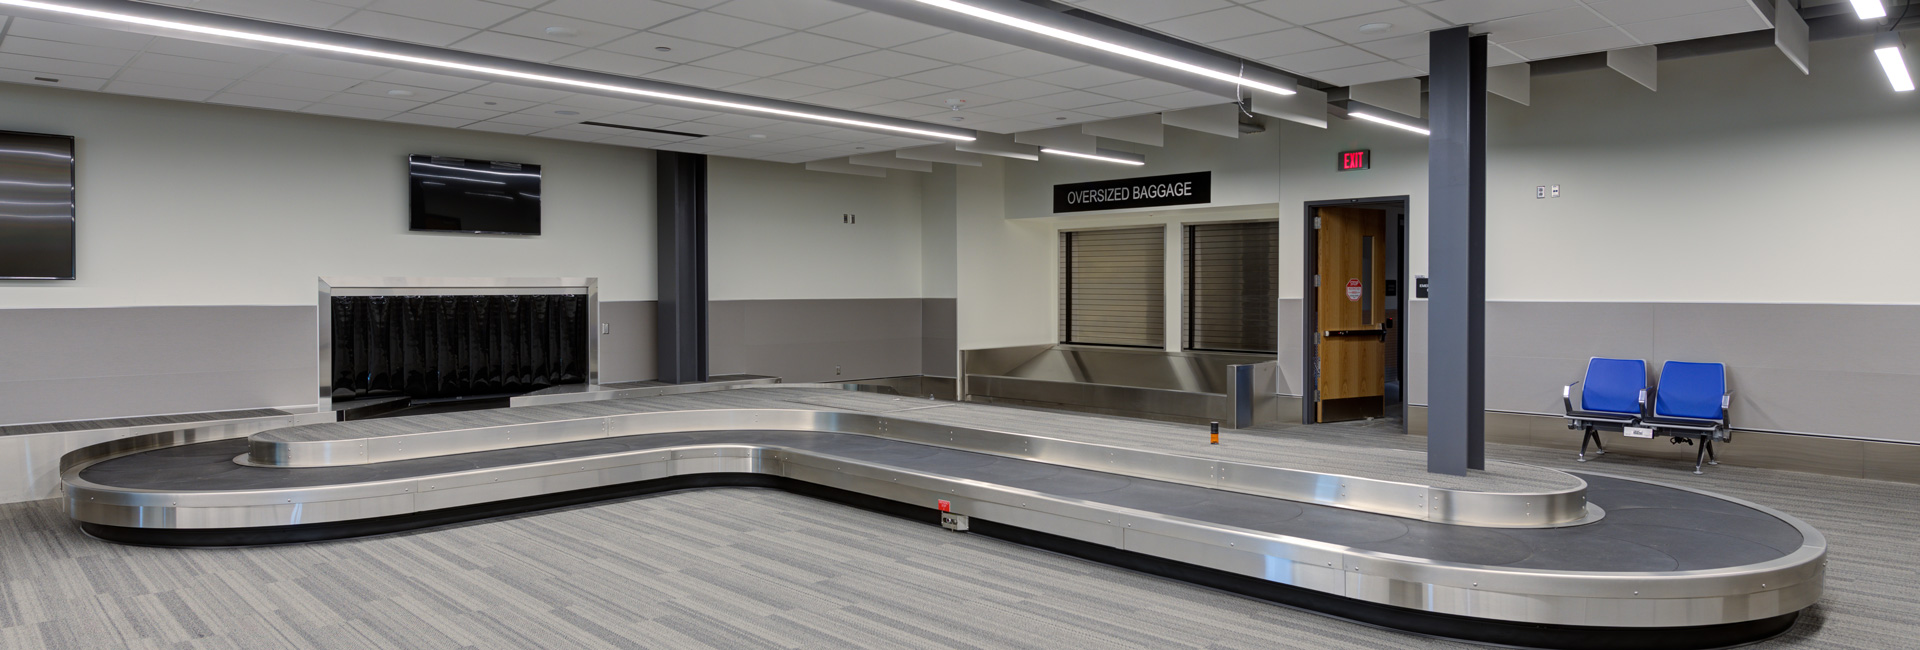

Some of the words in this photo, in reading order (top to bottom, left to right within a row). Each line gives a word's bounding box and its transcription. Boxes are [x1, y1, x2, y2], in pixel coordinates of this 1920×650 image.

[1343, 152, 1363, 169] EXIT
[1067, 187, 1130, 205] OVERSIZED
[1132, 181, 1192, 200] BAGGAGE
